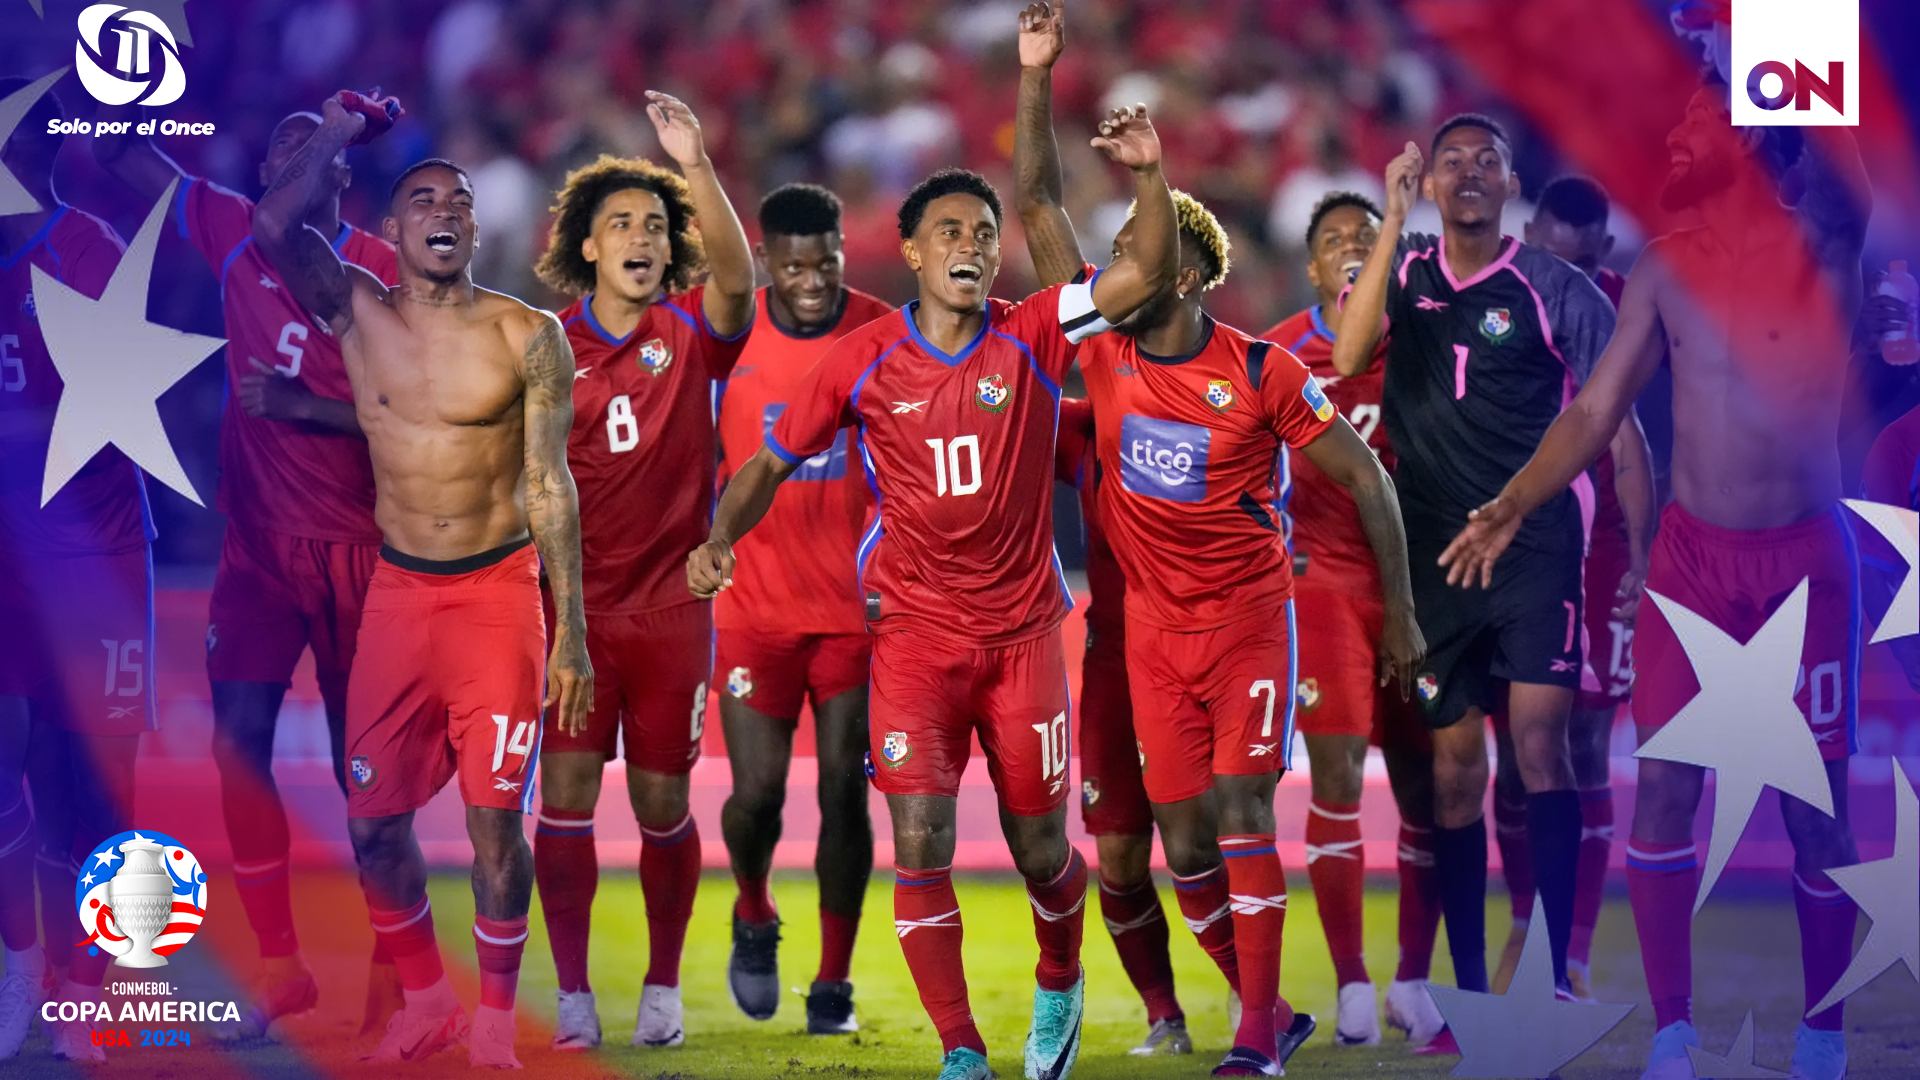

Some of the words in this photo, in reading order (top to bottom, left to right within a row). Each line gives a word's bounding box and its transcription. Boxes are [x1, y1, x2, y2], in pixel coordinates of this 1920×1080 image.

[0, 334, 27, 392] 5
[274, 321, 308, 378] 5
[1452, 343, 1470, 400] 1
[606, 394, 640, 454] 8
[924, 434, 983, 498] 10
[1131, 439, 1194, 487] tigo
[1563, 600, 1576, 653] 1
[100, 639, 144, 697] 15
[1793, 660, 1843, 725] 0
[1249, 679, 1276, 737] 7
[491, 714, 536, 775] 14
[1031, 710, 1067, 781] 10
